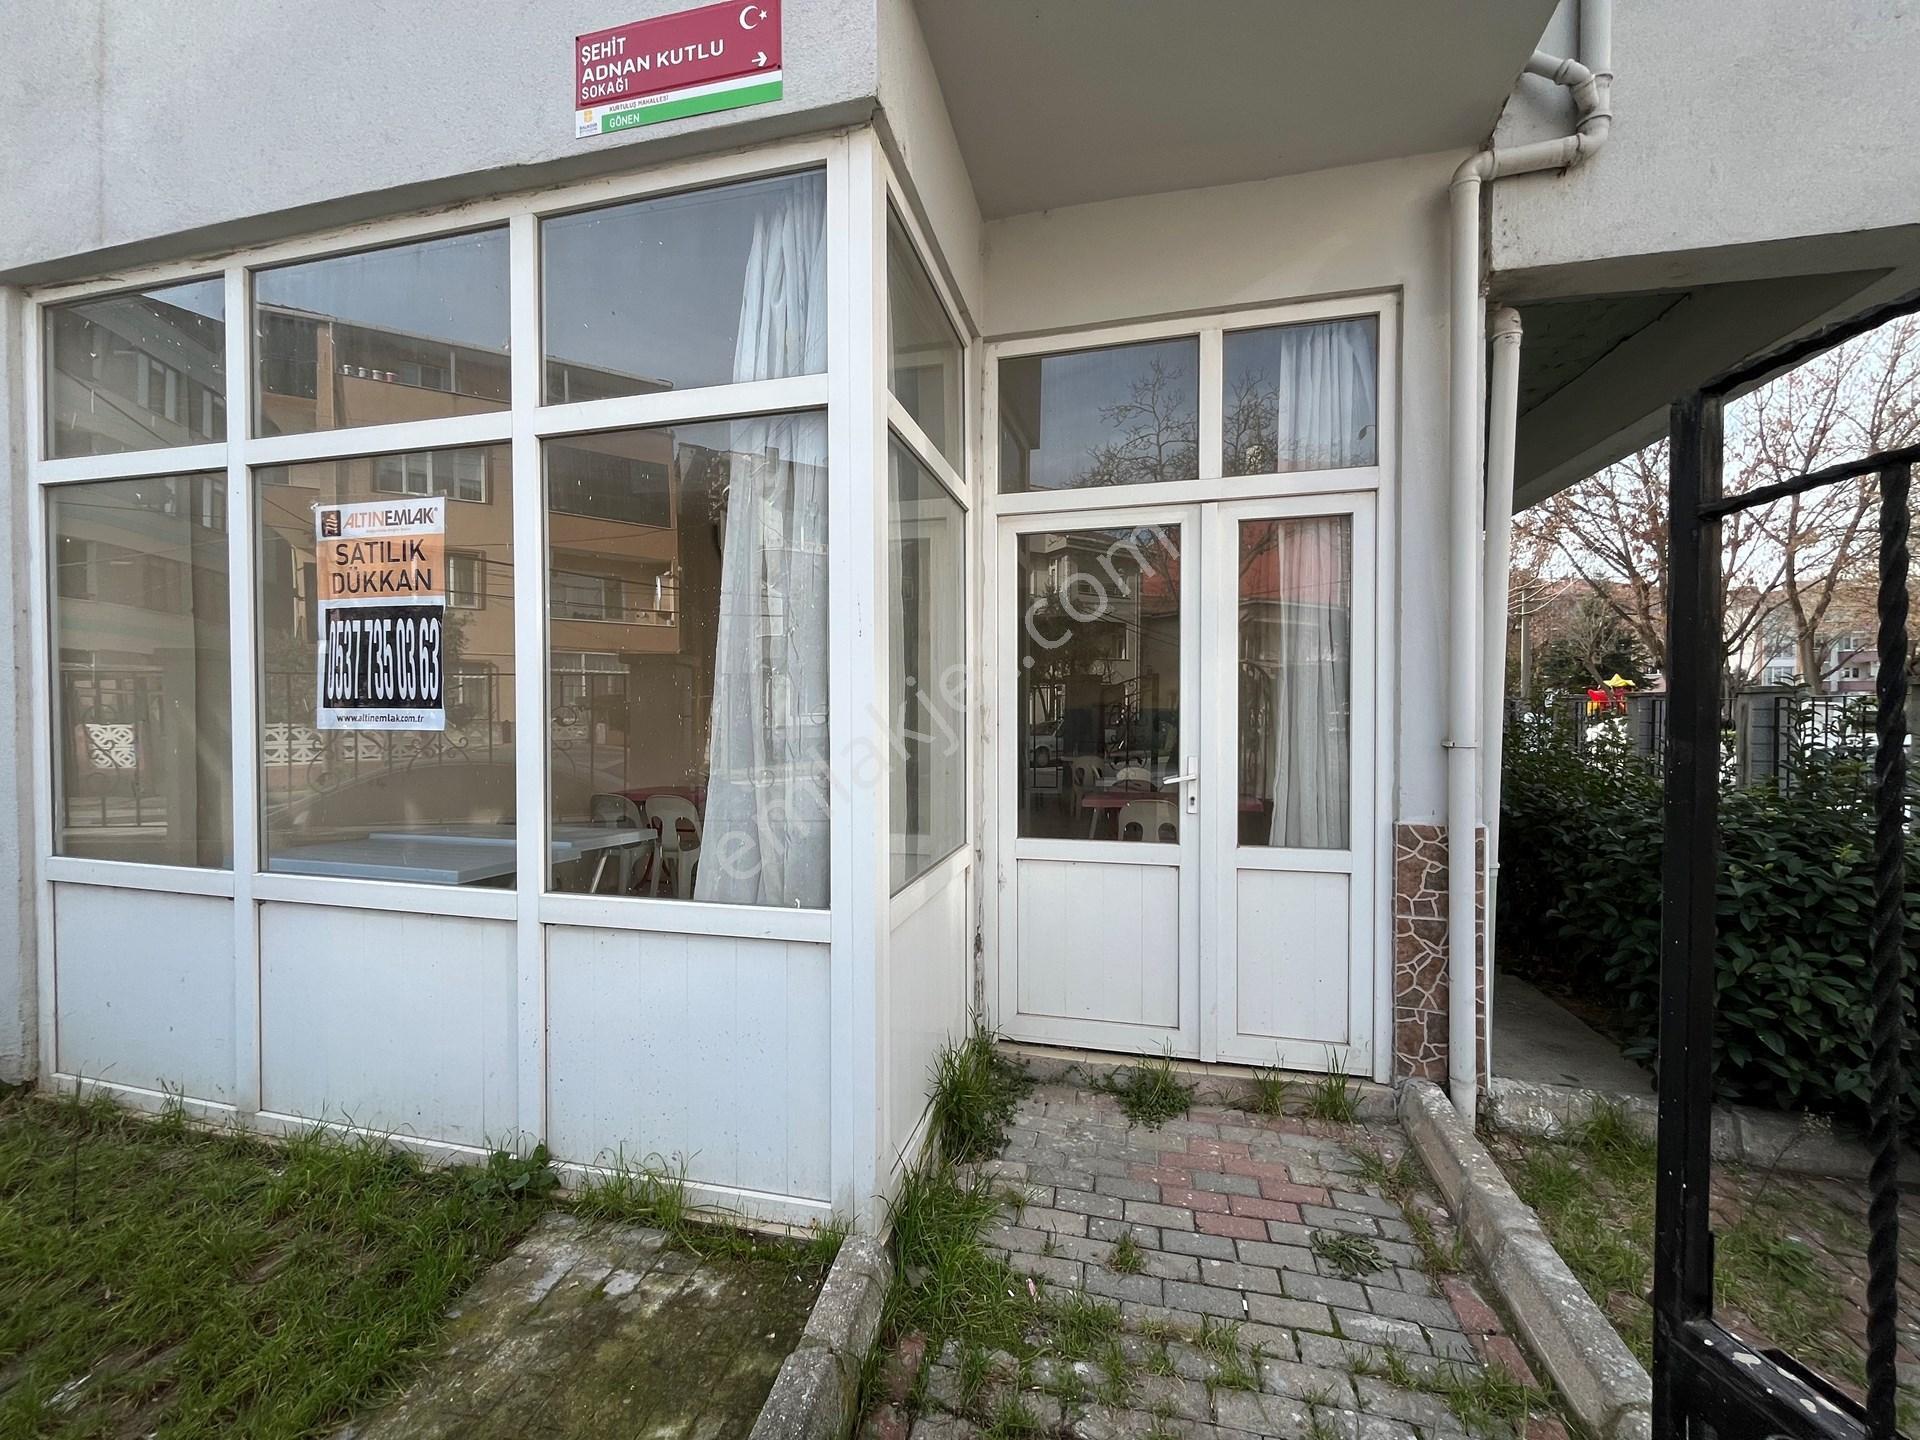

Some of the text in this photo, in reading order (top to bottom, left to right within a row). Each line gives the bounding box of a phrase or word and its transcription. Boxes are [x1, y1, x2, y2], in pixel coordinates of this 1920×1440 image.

[581, 36, 626, 66] ŞEHİT
[581, 39, 724, 84] ADNAN KUTLU
[581, 77, 629, 100] SOKAĞI
[609, 115, 640, 128] GÖNEN
[343, 507, 434, 530] ALTINEMLAK
[335, 538, 427, 566] SATILIK
[332, 567, 432, 595] DÜKKAN
[327, 617, 440, 701] 0537 735 03 63
